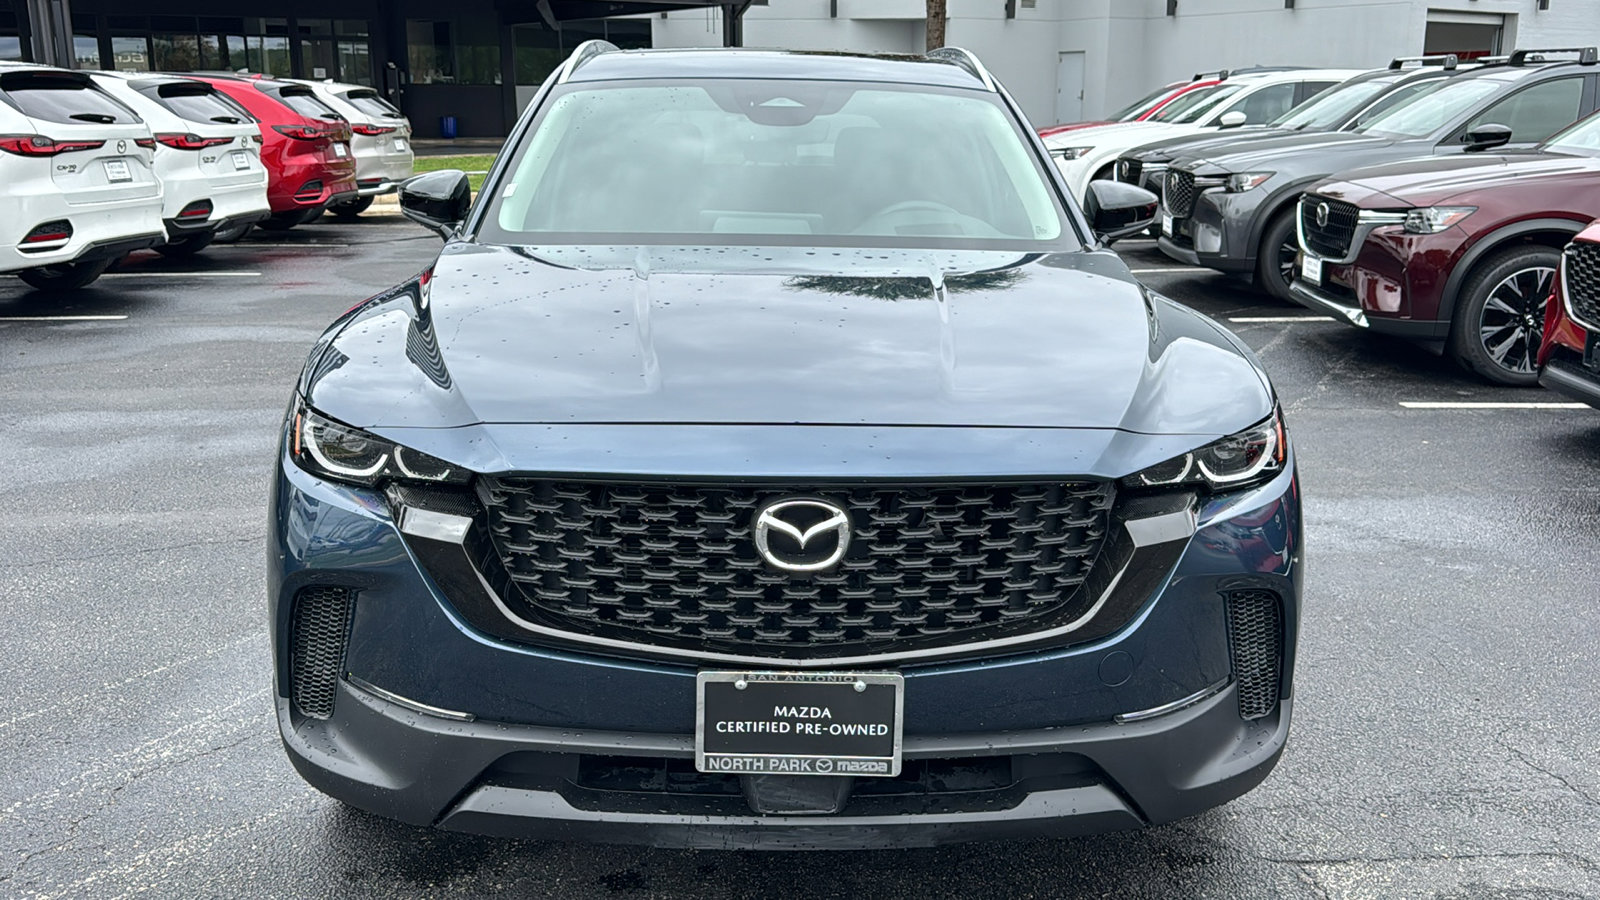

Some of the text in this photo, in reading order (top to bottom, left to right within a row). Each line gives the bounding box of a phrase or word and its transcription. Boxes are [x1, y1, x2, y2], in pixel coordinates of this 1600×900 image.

[747, 674, 855, 683] SAN ANTONIO
[773, 706, 832, 719] MAZDA
[716, 721, 888, 736] CERTIFIED PRE-OWNED
[709, 757, 888, 773] NORTH PARK mazda
